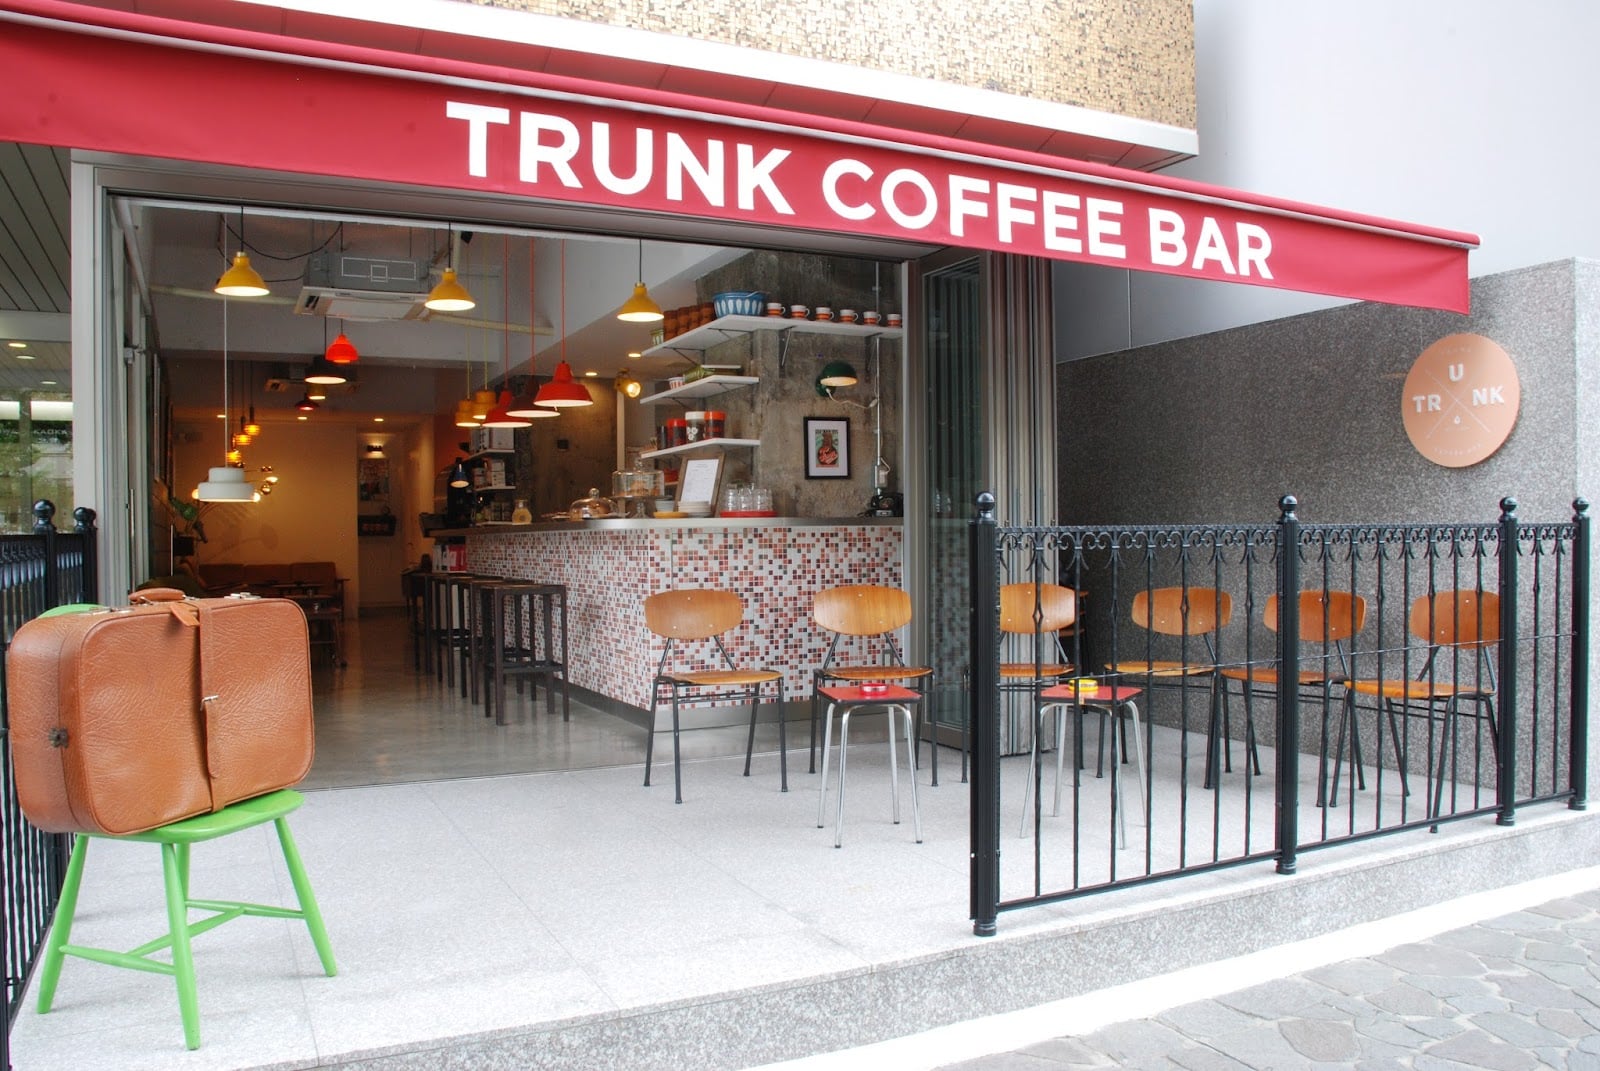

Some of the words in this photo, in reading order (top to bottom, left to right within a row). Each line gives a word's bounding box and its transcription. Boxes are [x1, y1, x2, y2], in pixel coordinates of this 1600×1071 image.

[446, 101, 795, 214] TRUNK
[822, 159, 1126, 259] COFFEE
[1148, 208, 1274, 279] BAR
[1448, 363, 1464, 382] U
[1412, 394, 1441, 413] TR
[1472, 386, 1505, 406] NK
